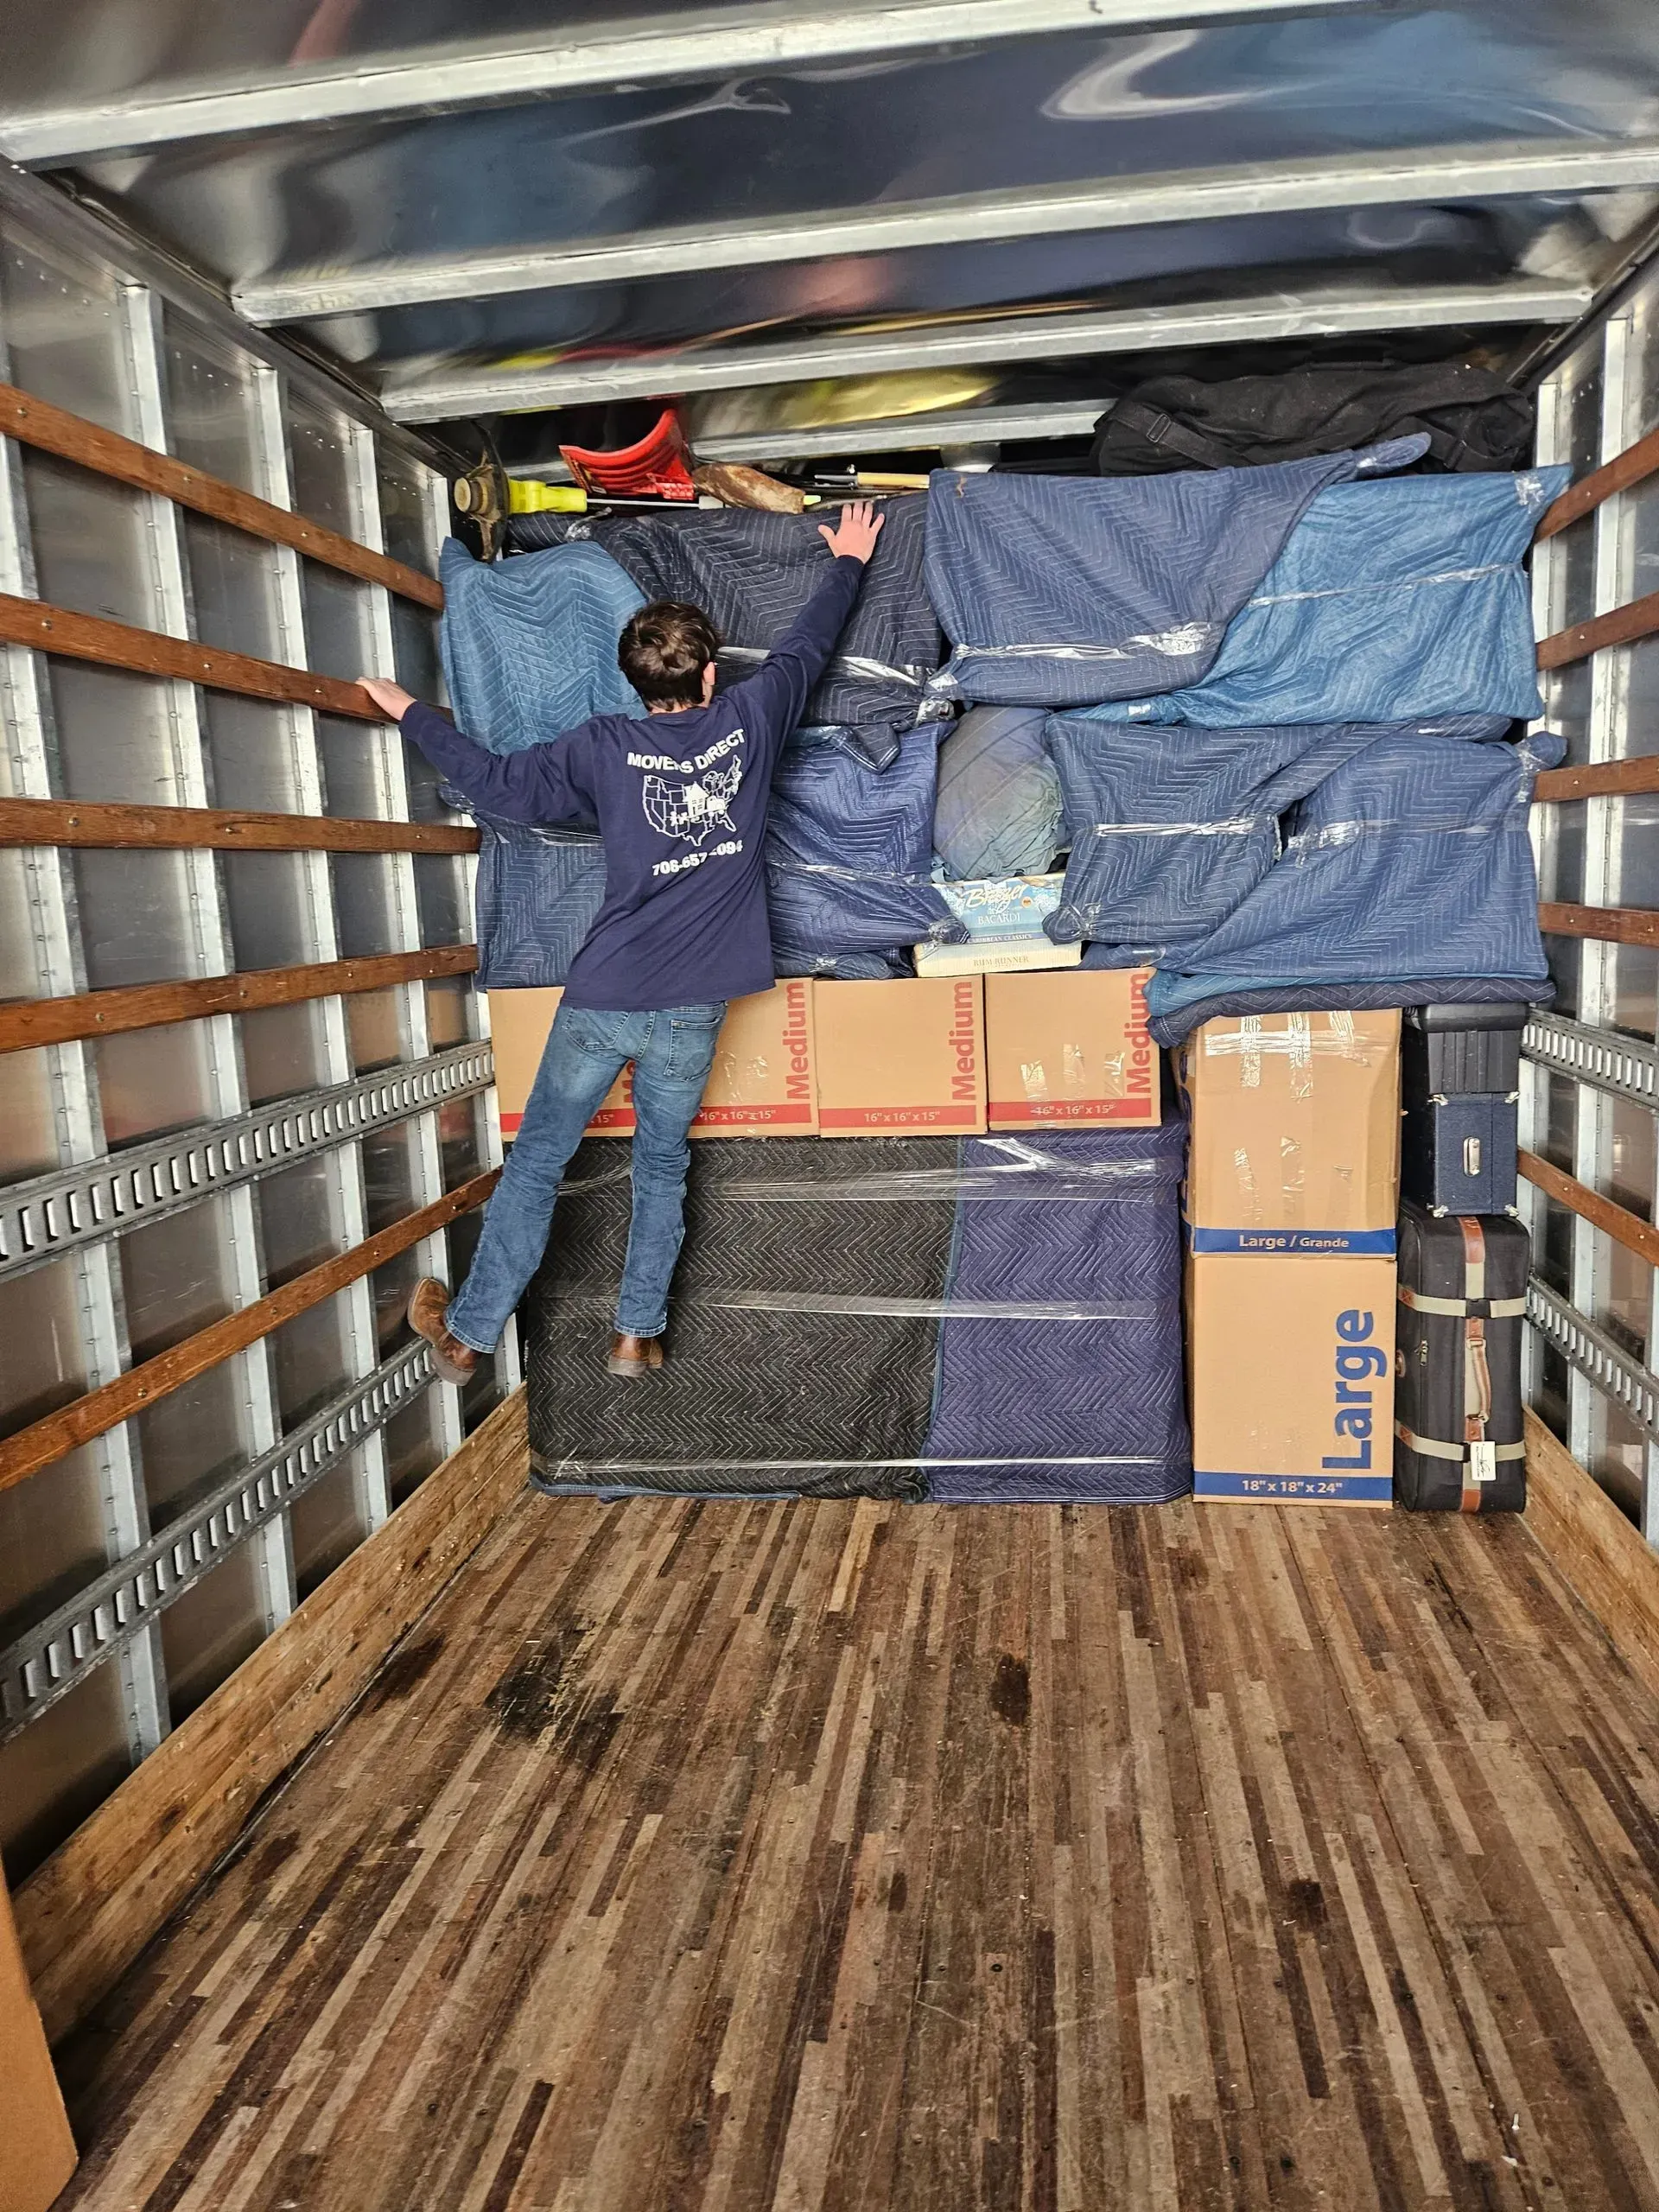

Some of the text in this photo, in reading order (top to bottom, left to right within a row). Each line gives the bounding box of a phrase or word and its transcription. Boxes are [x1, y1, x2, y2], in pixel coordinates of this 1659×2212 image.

[694, 728, 745, 770] DIRECT
[977, 912, 1020, 925] BACARDI
[973, 958, 993, 967] RUM
[995, 955, 1029, 965] RUNNER
[783, 982, 810, 1100] Medium
[949, 981, 976, 1101] Medium
[1124, 973, 1151, 1094] Medium
[729, 1109, 748, 1120] 16"
[758, 1109, 777, 1120] 15"
[864, 1112, 883, 1122] 16"
[893, 1111, 912, 1122] 16"
[912, 1113, 920, 1122] x
[921, 1110, 941, 1121] 15"
[1065, 1105, 1084, 1115] 16"
[1094, 1104, 1116, 1114] 15"
[596, 1113, 614, 1123] 15"
[1238, 1234, 1350, 1249] Large / Grande
[1321, 1308, 1388, 1470] Large
[1242, 1479, 1344, 1494] 18" x 18" x 24"
